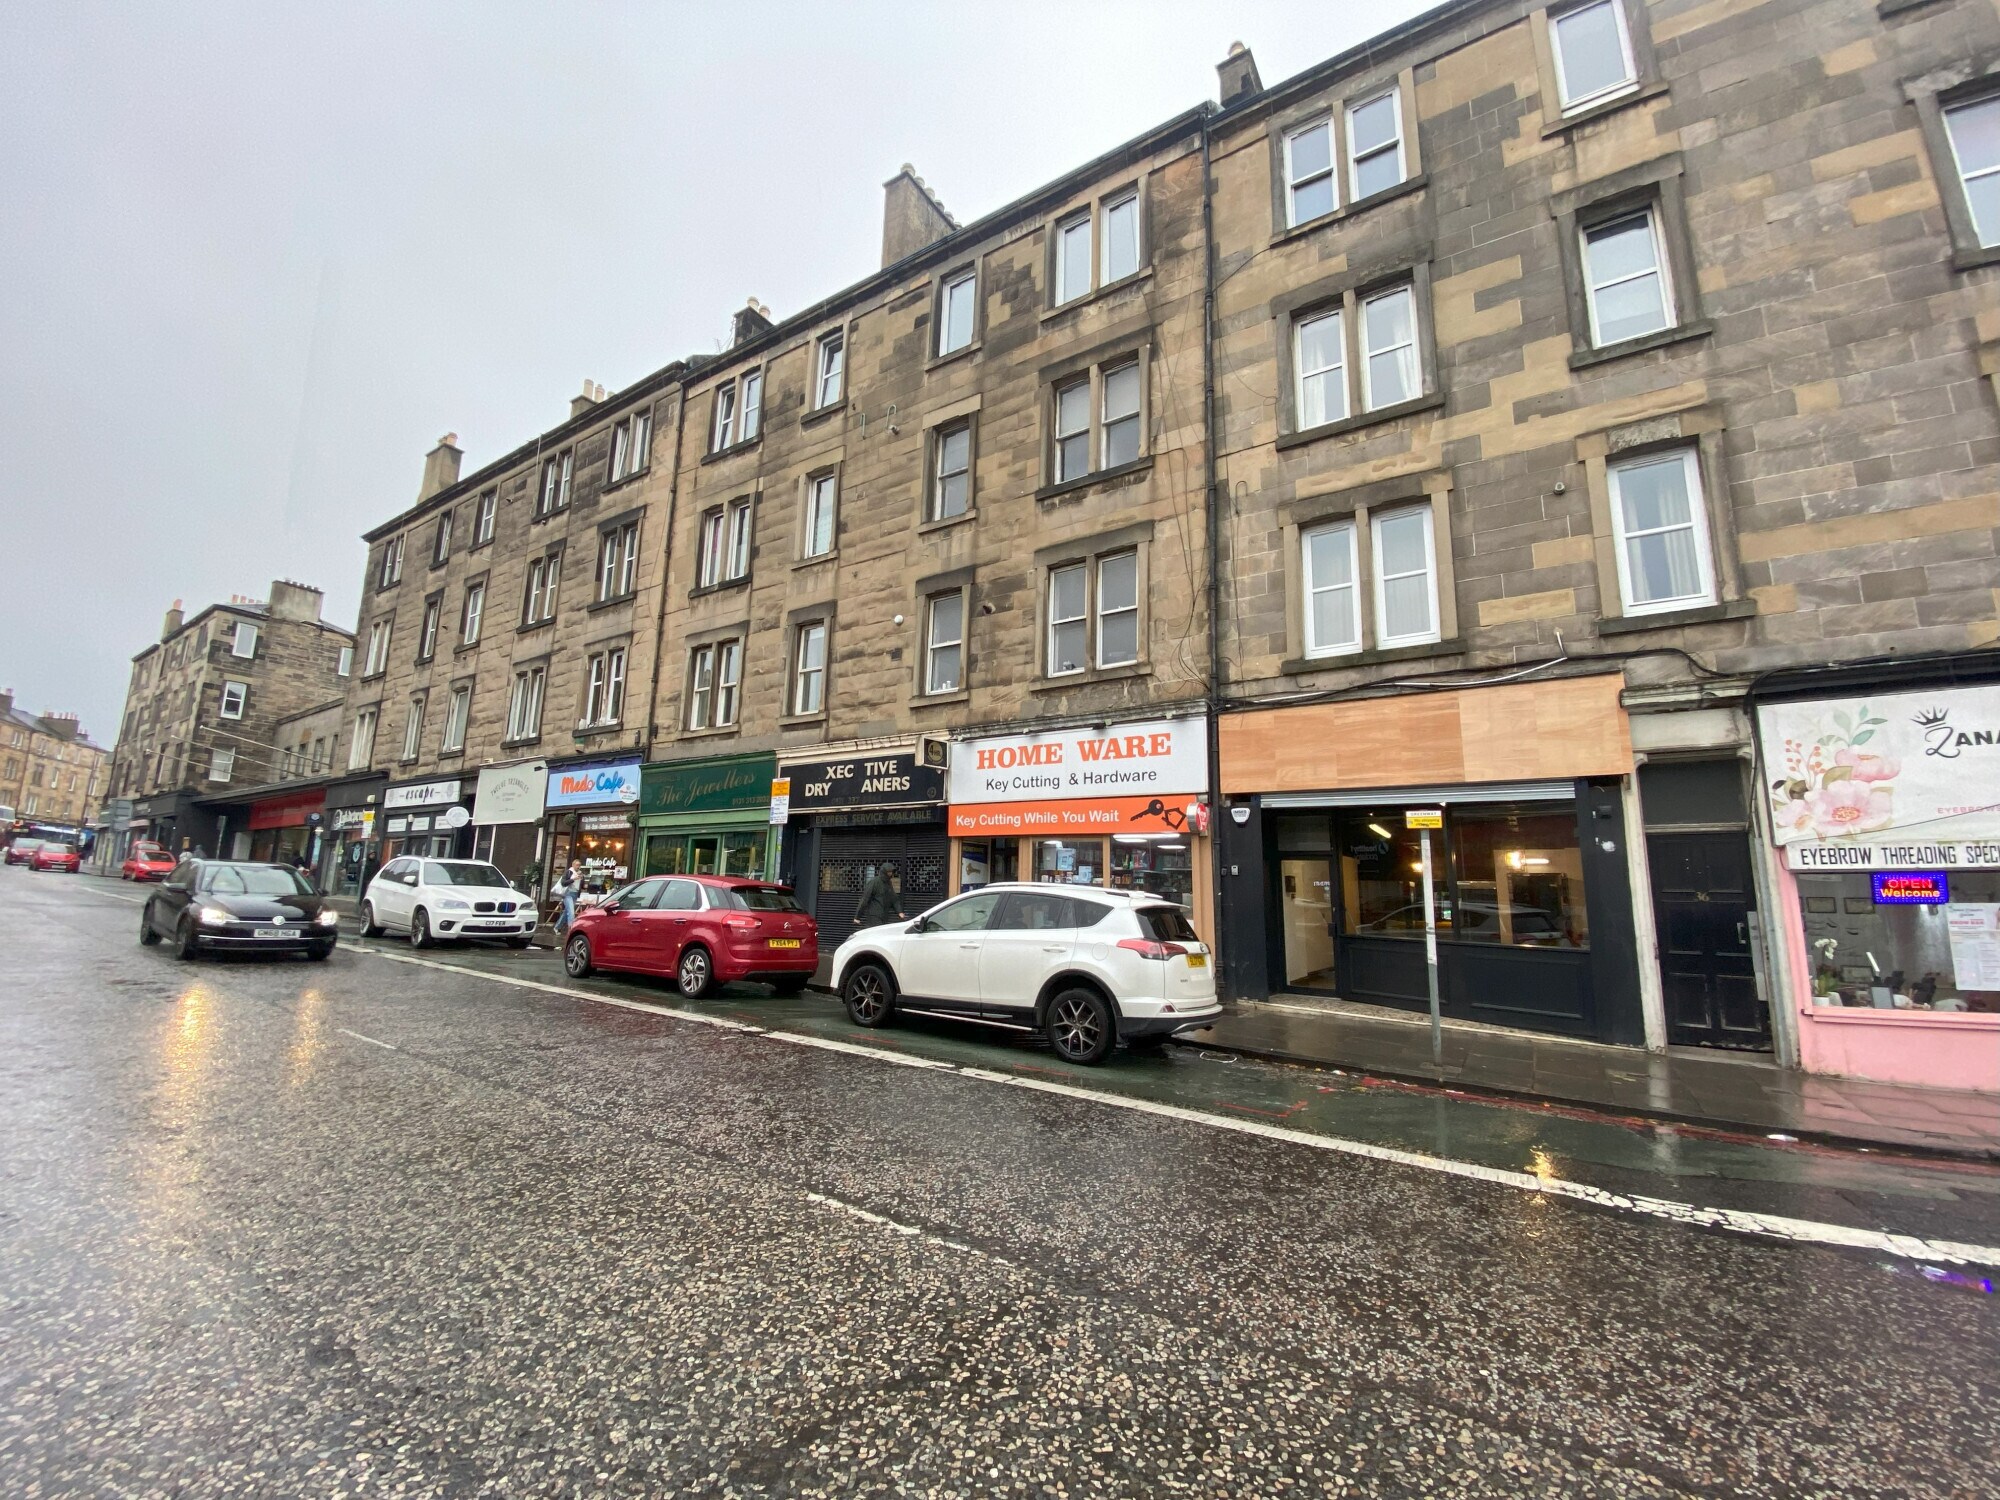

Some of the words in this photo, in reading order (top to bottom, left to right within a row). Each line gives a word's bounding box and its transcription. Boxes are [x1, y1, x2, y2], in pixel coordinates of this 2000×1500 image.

[976, 743, 1063, 770] HOME
[1077, 733, 1171, 762] WARE
[864, 760, 898, 776] TIVE
[561, 774, 595, 794] Medo
[596, 771, 626, 793] Cafe
[657, 785, 683, 806] The
[684, 769, 755, 807] Jewellers
[805, 782, 833, 797] DRY
[861, 776, 911, 793] ANERS
[986, 778, 1009, 793] Key
[1012, 776, 1060, 789] Cutting
[1068, 773, 1079, 785] &
[1083, 769, 1157, 785] Hardware
[405, 786, 434, 803] escape
[816, 814, 848, 825] EXPRESS
[852, 812, 883, 823] SERVICE
[887, 810, 932, 822] AVAILABLE
[956, 815, 976, 828] Key
[979, 812, 1021, 827] Cutting
[1024, 811, 1058, 824] While
[1062, 811, 1086, 824] You
[1088, 810, 1120, 823] Wait
[1801, 848, 1872, 866] EYEBROW
[1881, 846, 1957, 865] THREADING
[1880, 888, 1941, 898] Welcome
[1888, 879, 1933, 889] OPEN
